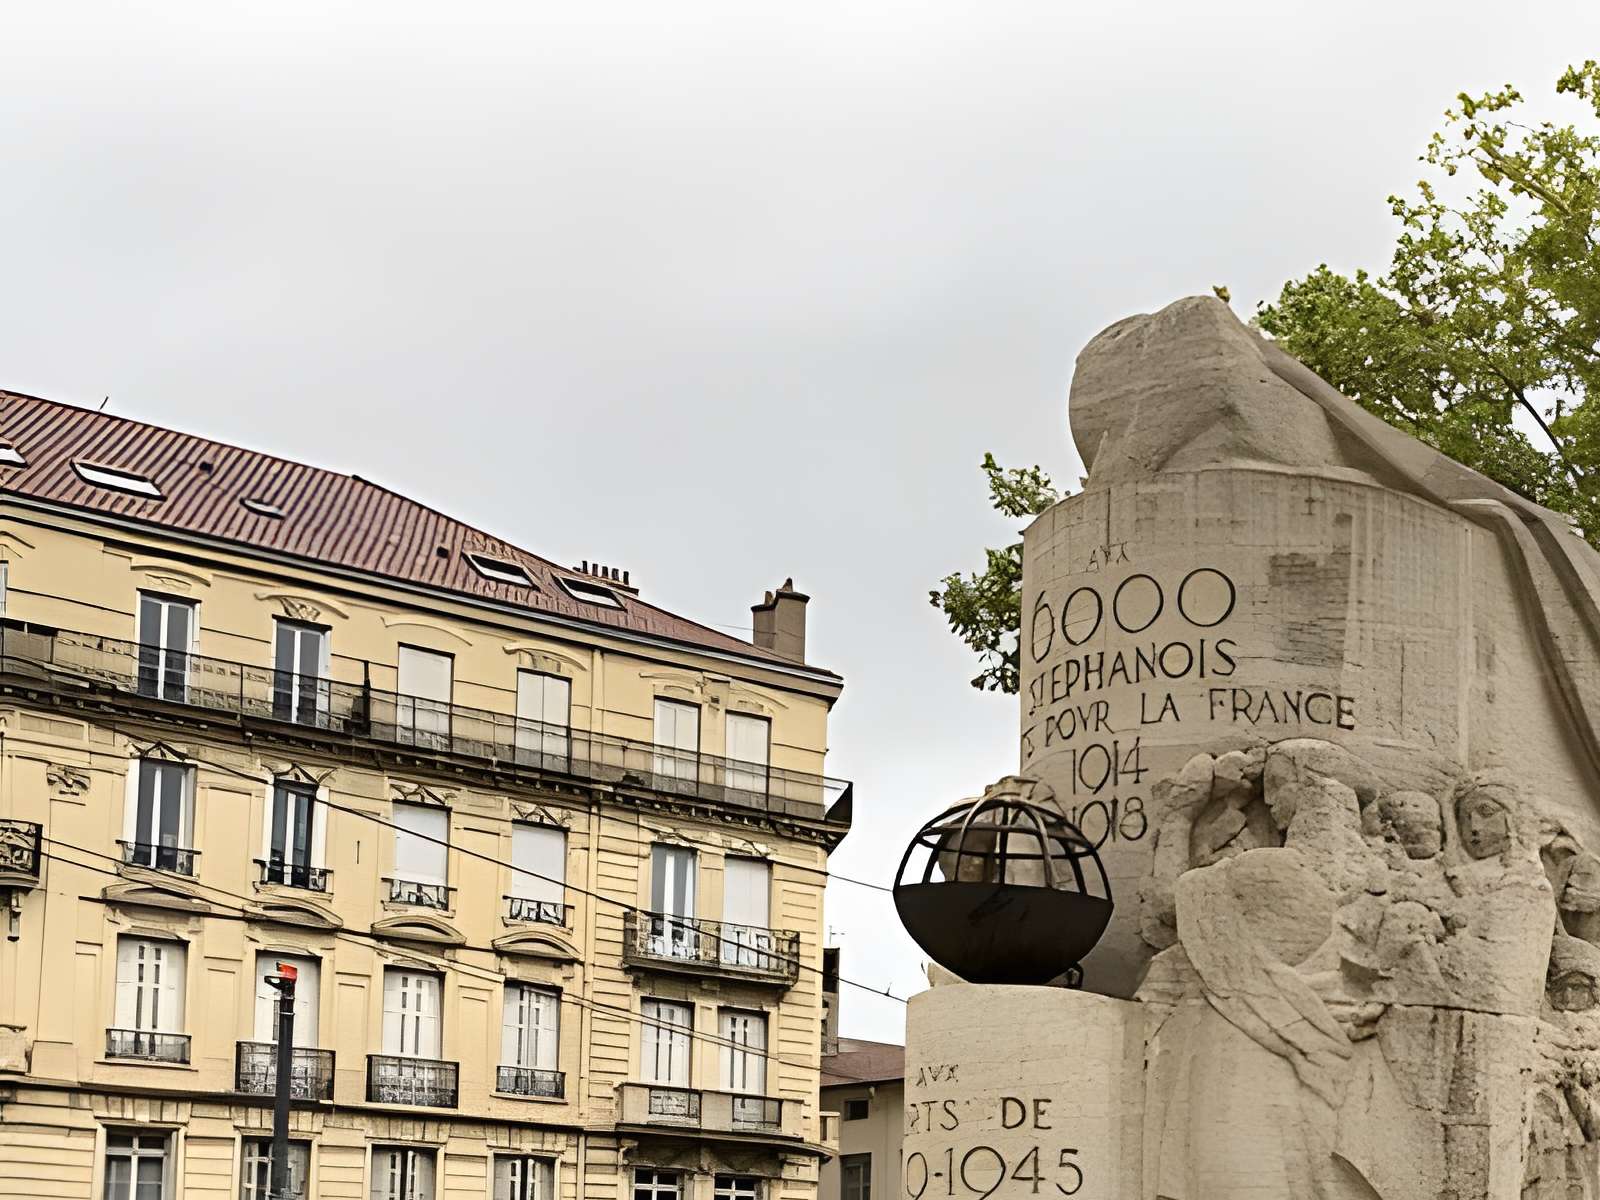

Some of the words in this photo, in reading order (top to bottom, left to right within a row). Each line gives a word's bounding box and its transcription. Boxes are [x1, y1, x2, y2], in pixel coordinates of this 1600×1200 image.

[1031, 567, 1237, 664] 6000
[1140, 692, 1181, 725] LA
[1209, 687, 1356, 731] FRANCE
[1072, 736, 1150, 795] 1914
[999, 1096, 1052, 1130] DE
